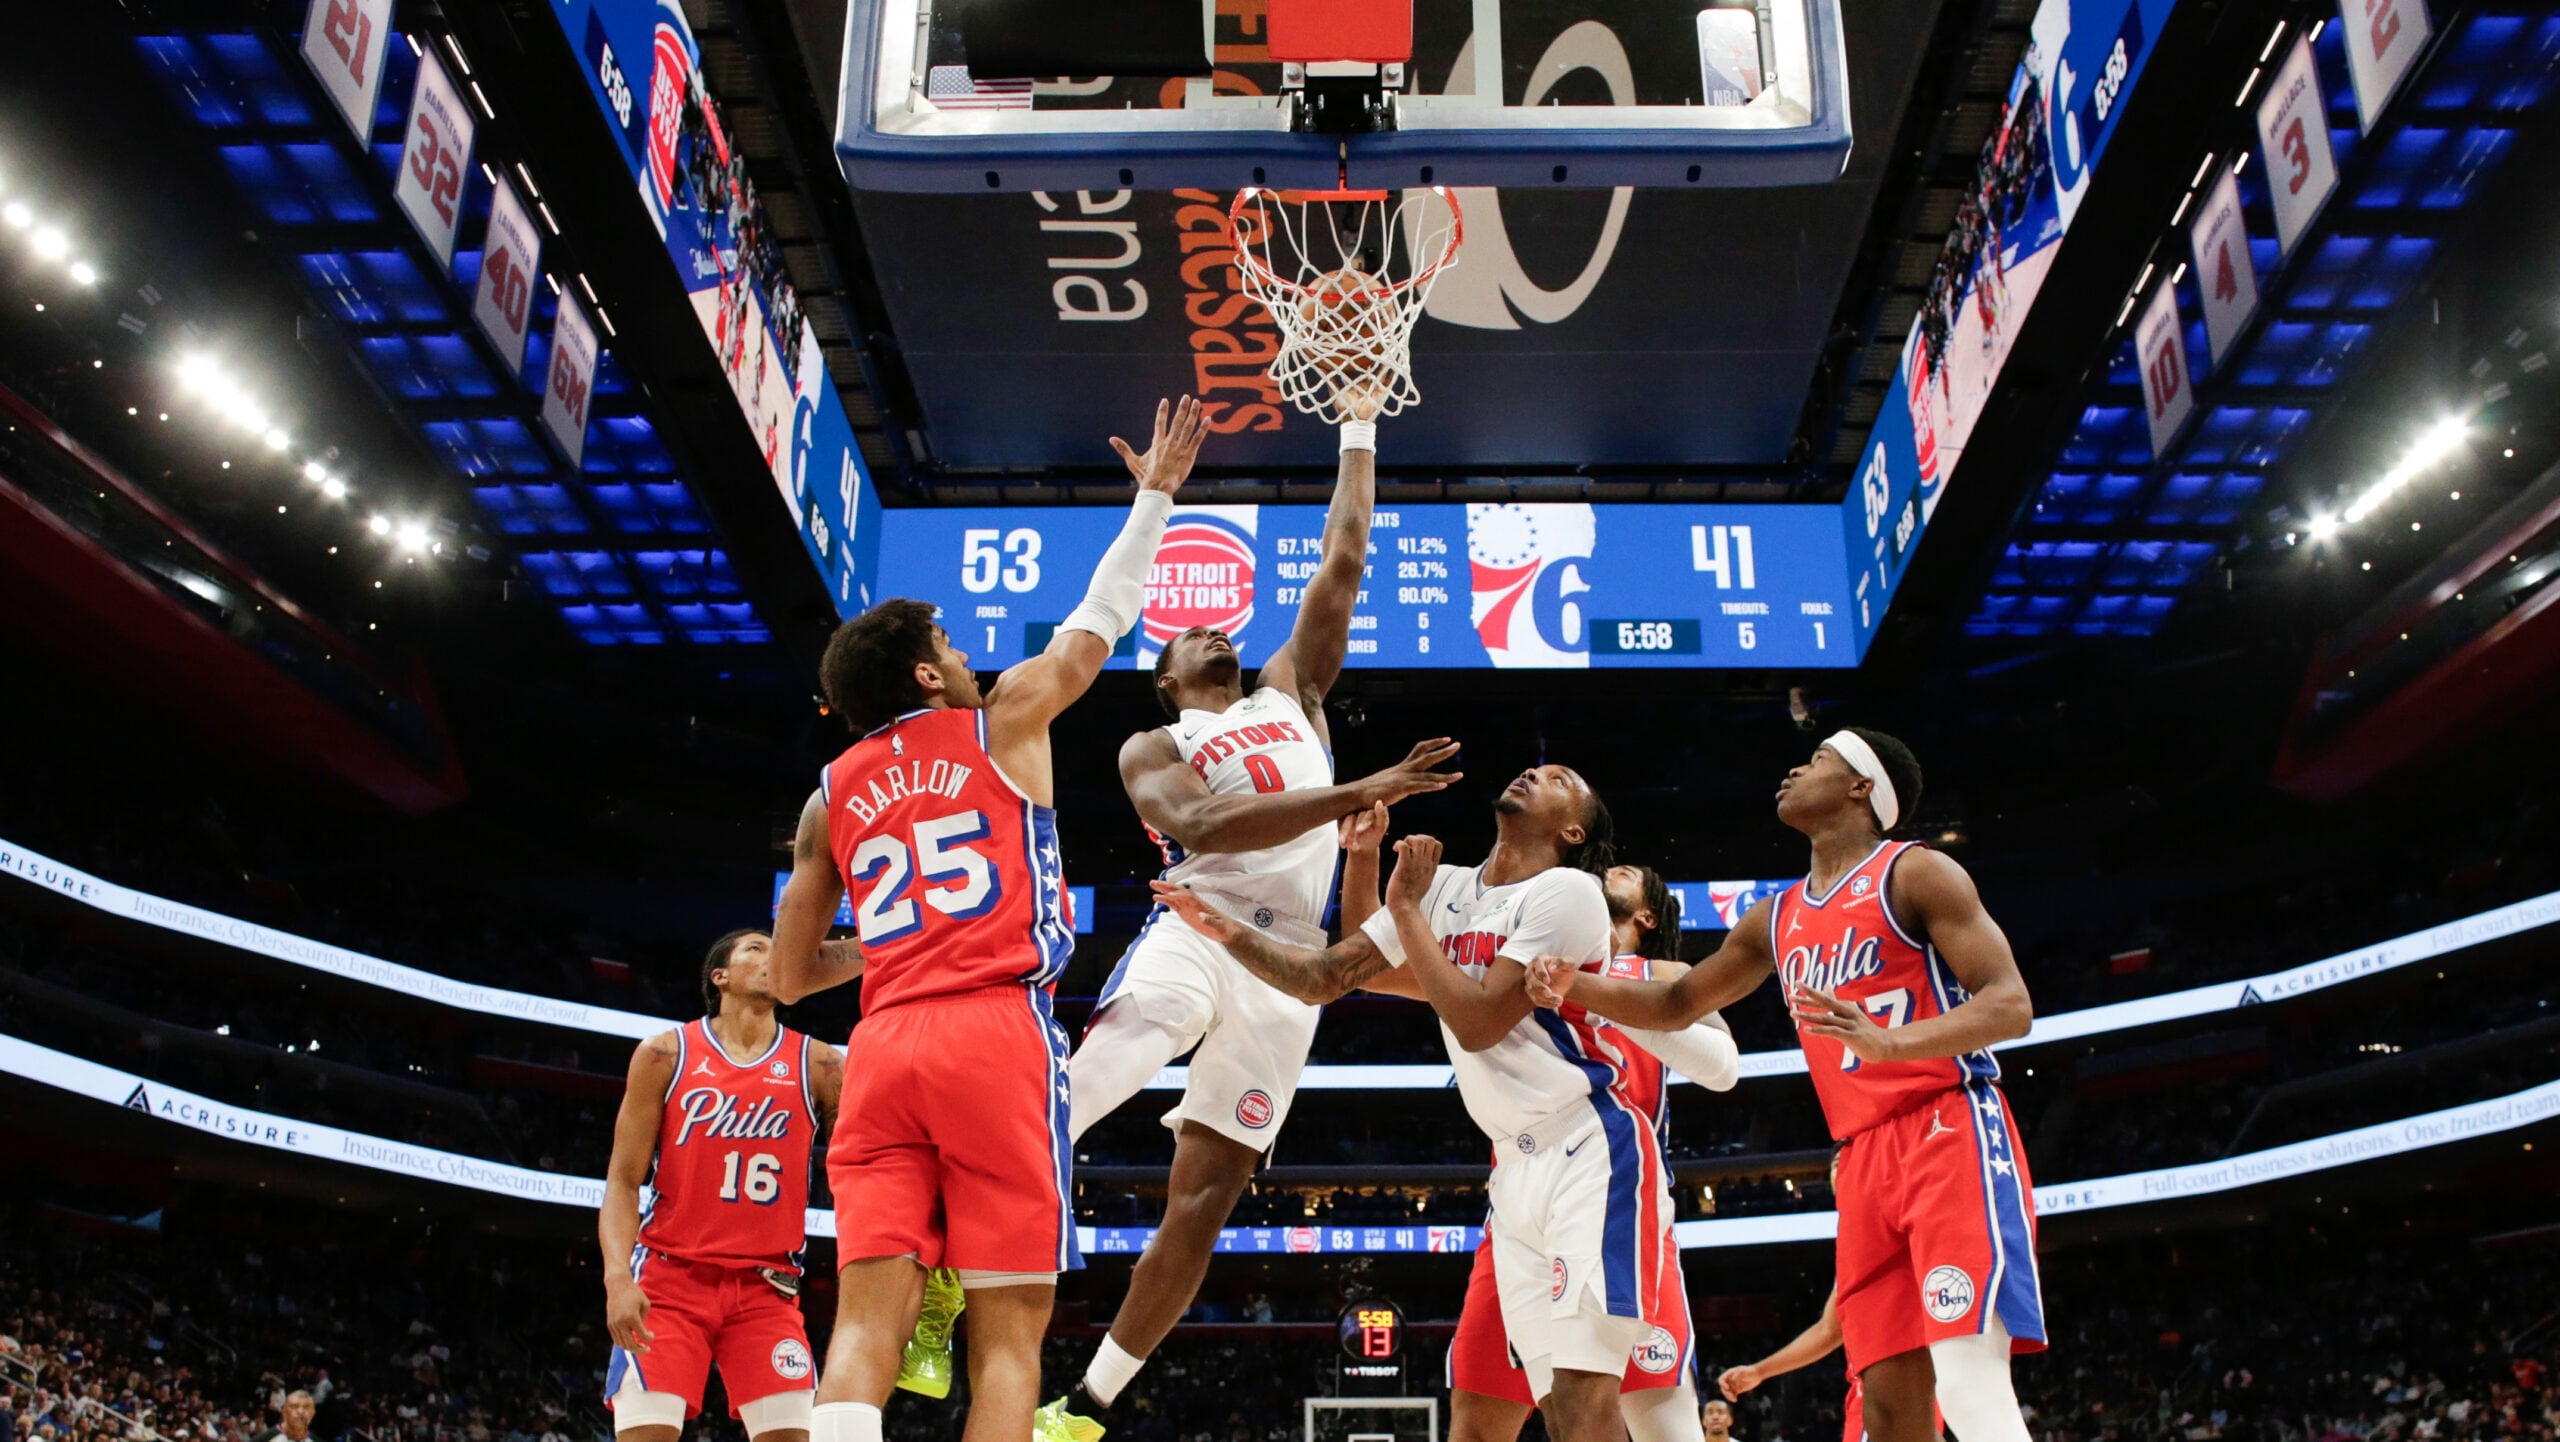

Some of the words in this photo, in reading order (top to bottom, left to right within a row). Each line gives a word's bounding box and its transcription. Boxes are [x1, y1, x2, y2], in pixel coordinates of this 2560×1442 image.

[323, 0, 371, 89] 21
[601, 43, 632, 128] 5:58
[2094, 38, 2128, 121] 5:58
[1713, 89, 1741, 106] NBA
[411, 113, 460, 229] 32
[2283, 117, 2310, 195] 3
[2216, 239, 2238, 304] 4
[486, 245, 528, 335] 40
[2150, 337, 2180, 422] 10
[840, 446, 861, 542] 41
[1863, 441, 1890, 539] 53
[1371, 512, 1400, 528] TATS
[961, 528, 1042, 593] 53
[1277, 538, 1323, 555] 57.1%
[1398, 537, 1448, 555] 41.2%
[1691, 525, 1755, 589] 41
[1147, 562, 1240, 585] DETROIT
[1398, 561, 1448, 579] 26.7%
[1144, 586, 1240, 609] PISTONS
[1276, 587, 1304, 605] 87.
[1398, 587, 1449, 604] 90.0%
[1720, 602, 1770, 616] TIMEOUTS:
[1801, 602, 1833, 616] FOULS:
[976, 605, 1008, 619] FOULS:
[1418, 612, 1430, 630] 5
[985, 625, 996, 653] 1
[1418, 636, 1430, 653] 8
[1617, 622, 1673, 650] 5:58
[1738, 621, 1756, 650] 5
[1813, 621, 1826, 650] 1
[1190, 721, 1304, 783] PISTONS
[1243, 754, 1285, 795] 0
[845, 759, 972, 827] BARLOW
[850, 809, 1003, 948] 25
[348, 956, 426, 991] Employee
[499, 996, 531, 1014] and
[1783, 927, 1884, 1028] Phila
[2271, 953, 2388, 996] ACRISURE
[162, 1099, 298, 1146] ACRISURE
[675, 1087, 794, 1146] Phila
[2234, 1152, 2307, 1180] business
[2404, 1122, 2446, 1144] One
[2450, 1102, 2513, 1135] trusted
[342, 1135, 434, 1172] Insurance,
[436, 1156, 558, 1198] Cybersecurity,
[720, 1150, 783, 1206] 16
[1332, 1230, 1354, 1250] 53
[1395, 1230, 1414, 1249] 41
[1927, 1288, 1970, 1309] 76ers
[1358, 1310, 1394, 1329] 5:58
[1364, 1327, 1392, 1357] 13
[1636, 1344, 1673, 1361] 76ers
[1358, 1366, 1399, 1377] TISSOT
